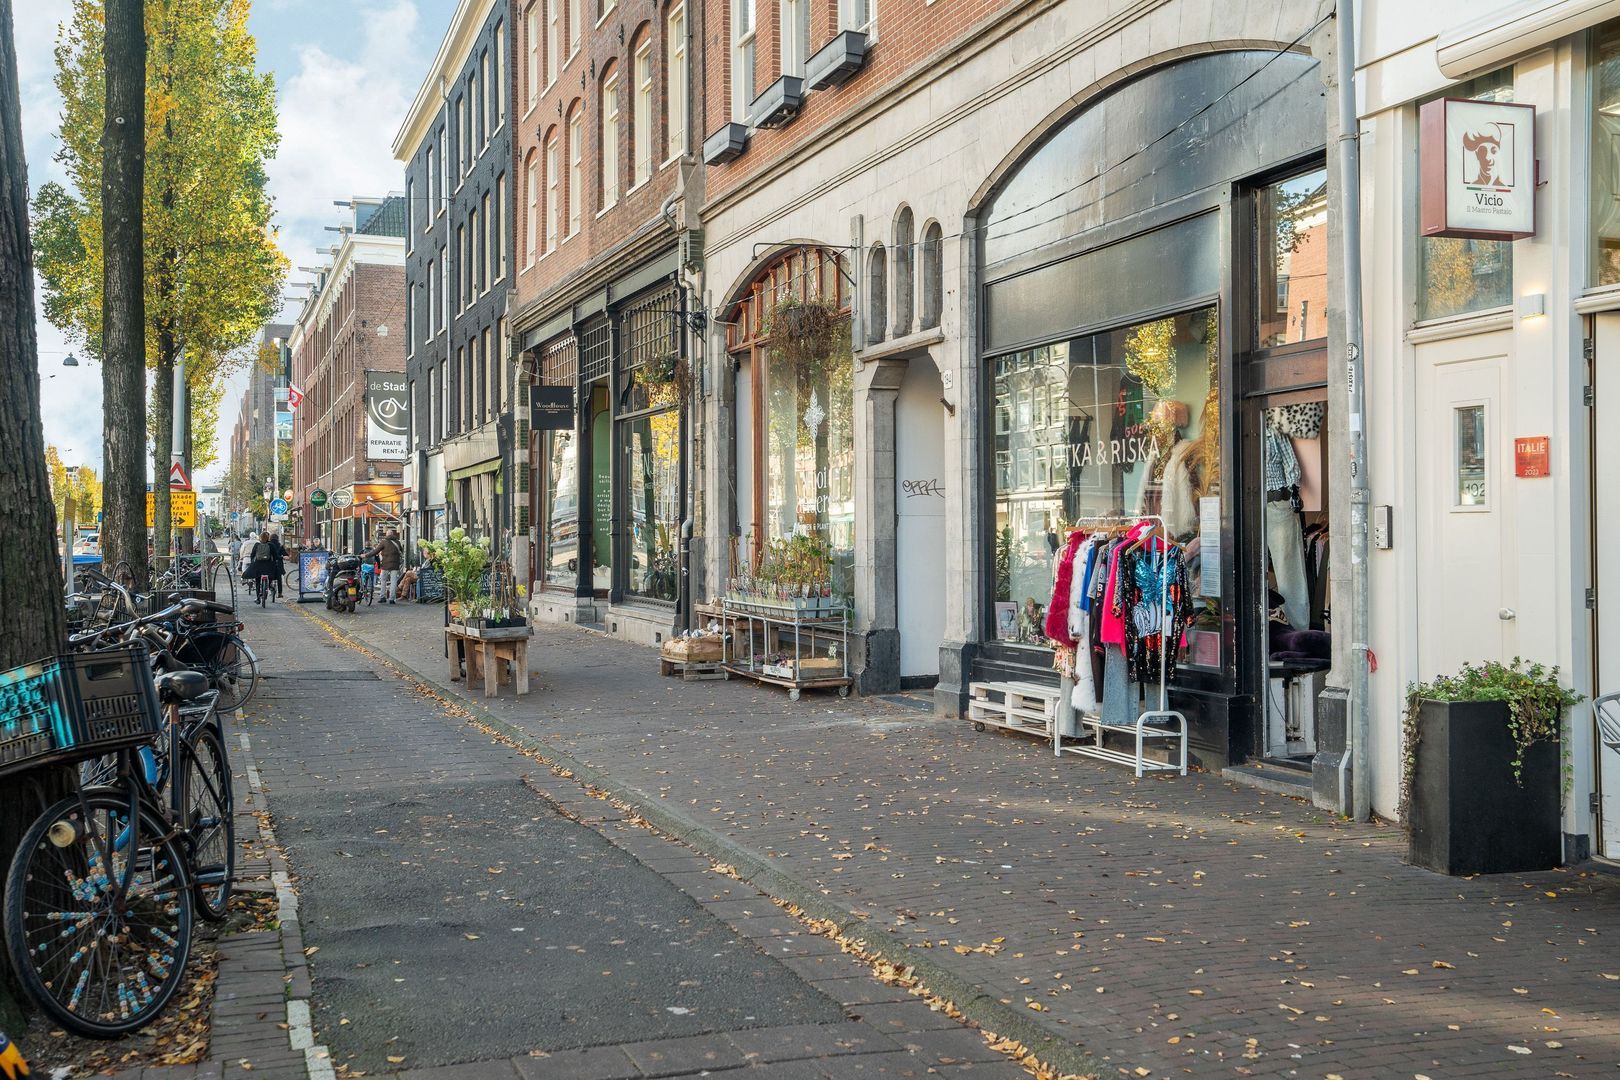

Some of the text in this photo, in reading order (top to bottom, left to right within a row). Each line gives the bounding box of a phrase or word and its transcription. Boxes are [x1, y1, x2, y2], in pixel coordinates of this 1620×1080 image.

[1475, 193, 1504, 206] Vicio
[1472, 206, 1492, 214] Mastro
[370, 381, 381, 391] de
[1096, 440, 1108, 465] &
[1111, 436, 1160, 464] RISKA
[1517, 442, 1545, 453] ITALIE
